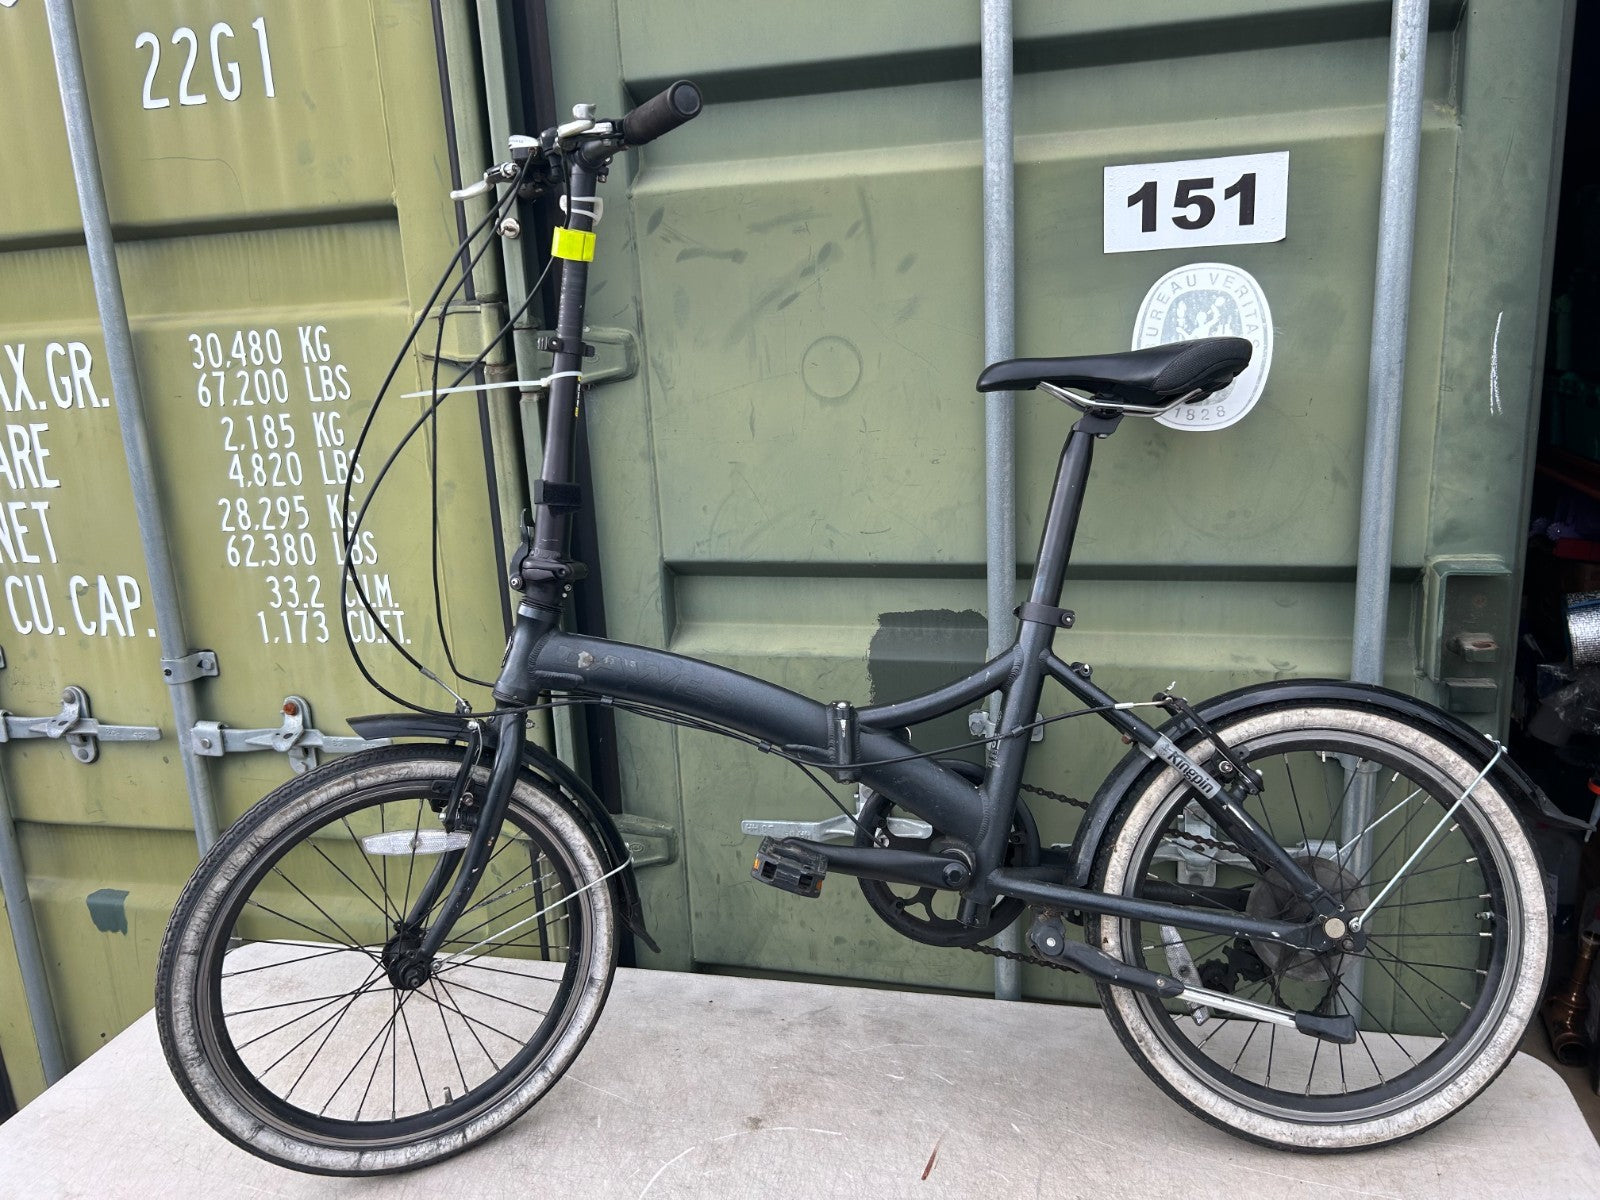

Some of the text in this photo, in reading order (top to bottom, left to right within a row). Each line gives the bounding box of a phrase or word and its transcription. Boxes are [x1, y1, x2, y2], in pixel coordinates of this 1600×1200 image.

[135, 17, 275, 109] 22G1
[1127, 172, 1257, 233] 151
[188, 325, 331, 369] 30,480 KG
[198, 364, 351, 407] 67,200 LBS
[221, 411, 345, 451] 2,185 KG
[1174, 405, 1226, 421] 1828
[229, 449, 365, 487] 4,820 LBS
[218, 495, 310, 532] 28,295
[227, 532, 317, 567] 62,380
[266, 574, 324, 608] 33.2
[257, 610, 329, 644] 1,173
[1167, 750, 1214, 794] Kingpin
